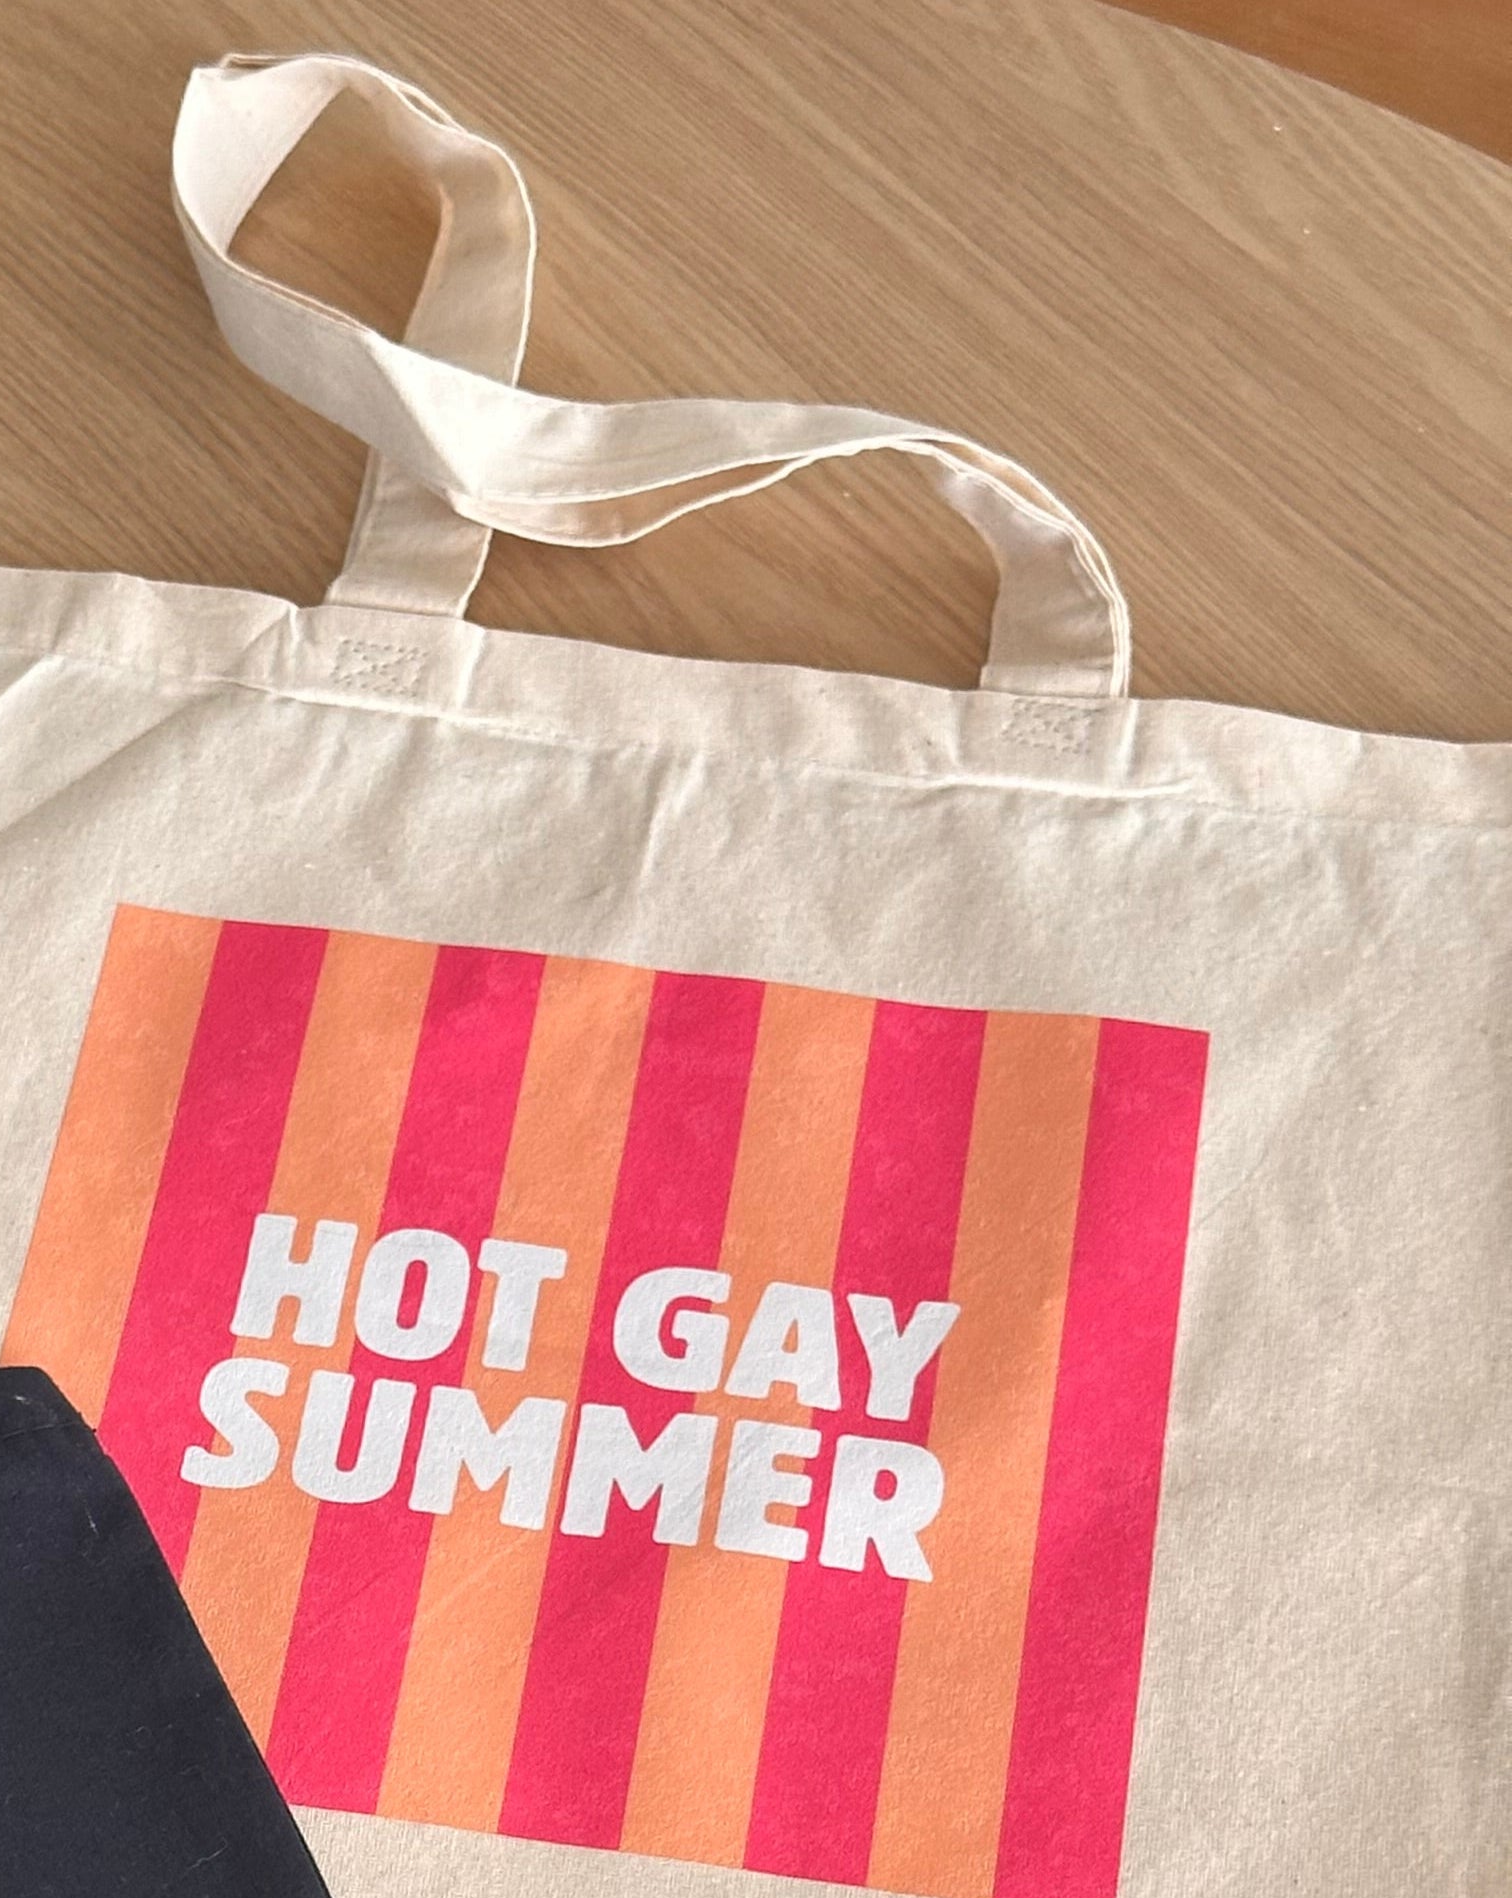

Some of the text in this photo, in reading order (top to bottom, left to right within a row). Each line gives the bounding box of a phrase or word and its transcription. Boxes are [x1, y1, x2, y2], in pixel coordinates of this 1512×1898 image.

[231, 1213, 962, 1422] HOT GAY
[180, 1356, 947, 1584] SUMMER
